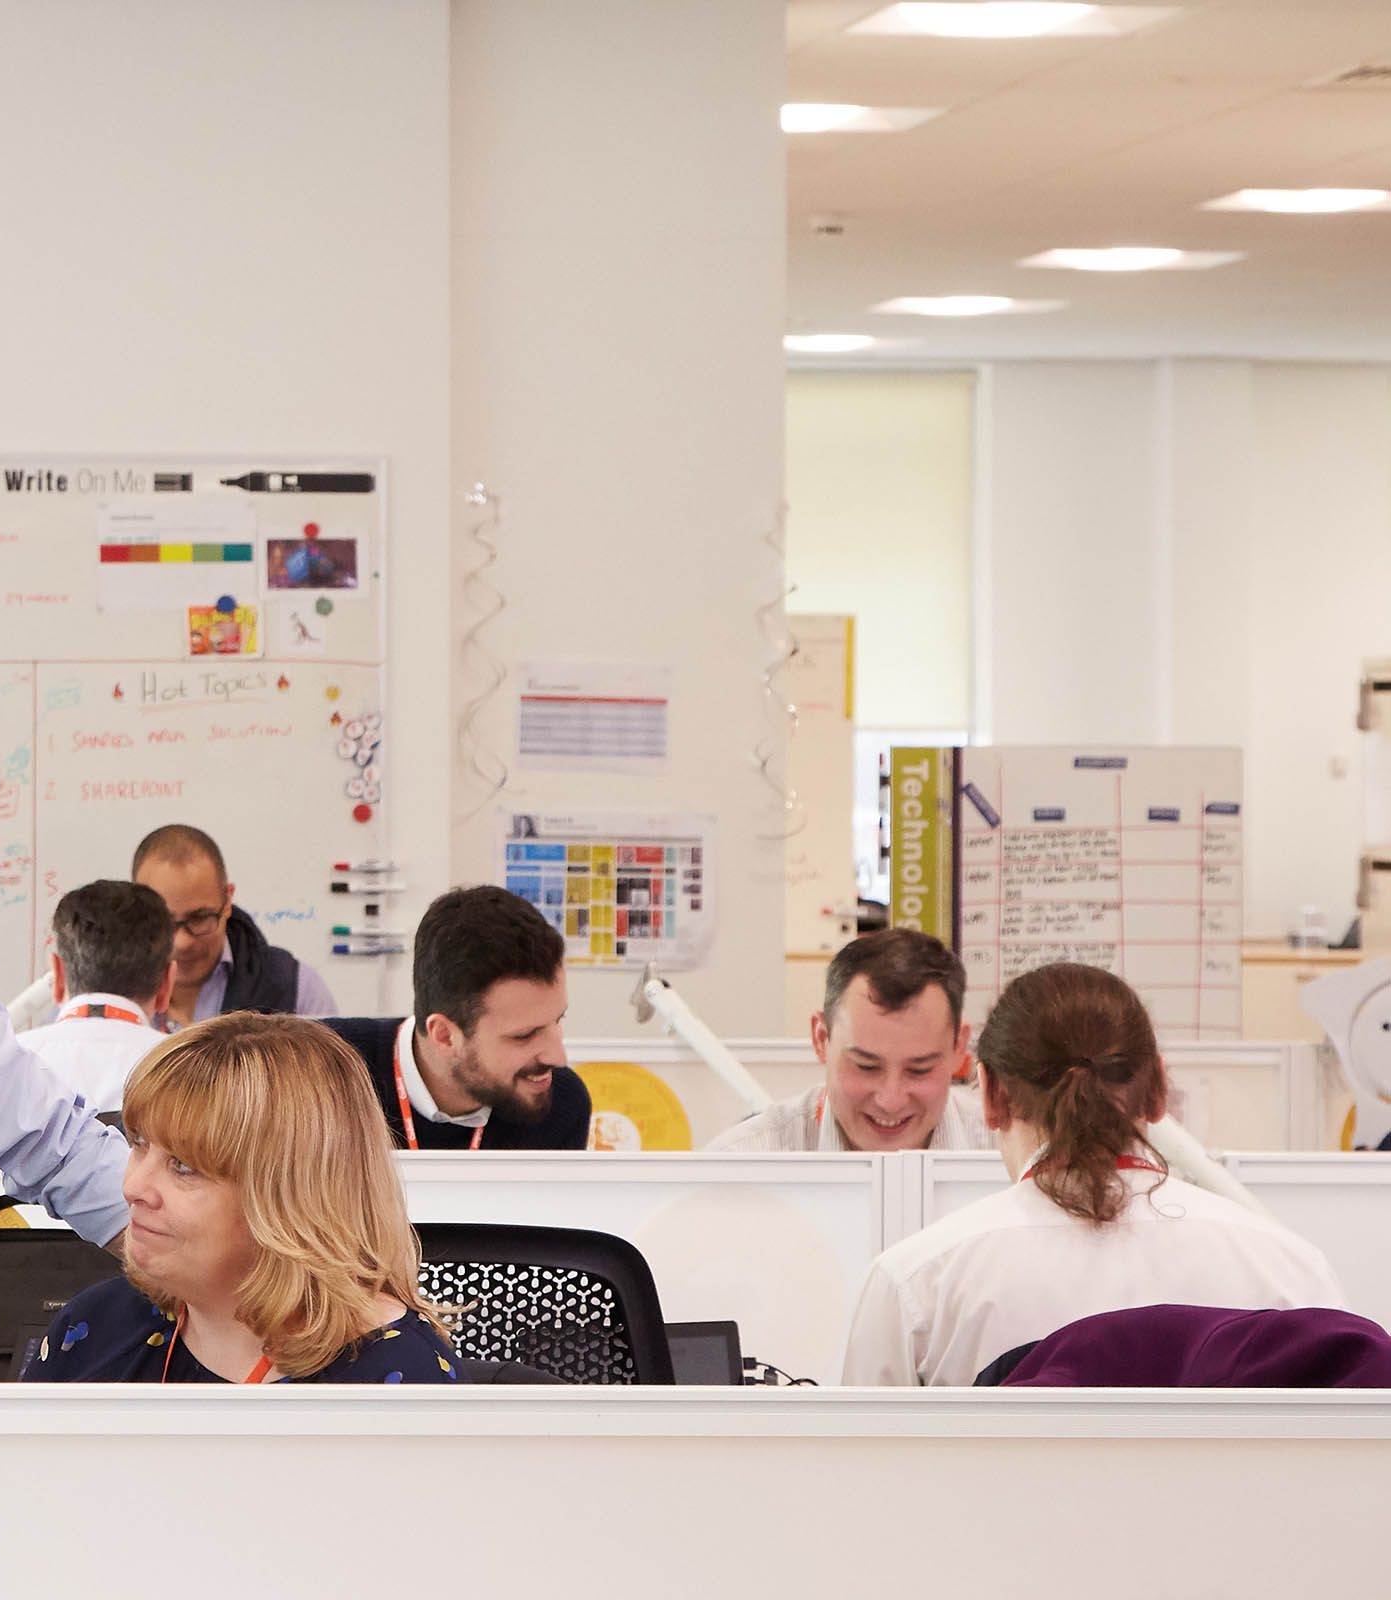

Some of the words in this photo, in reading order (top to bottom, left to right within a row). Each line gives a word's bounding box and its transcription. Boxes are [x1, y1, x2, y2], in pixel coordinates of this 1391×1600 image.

[5, 469, 68, 492] Write
[77, 470, 105, 492] On
[115, 470, 146, 492] Me
[142, 672, 189, 703] Hot
[200, 672, 268, 703] Topics
[81, 780, 185, 801] SHAREPOINT
